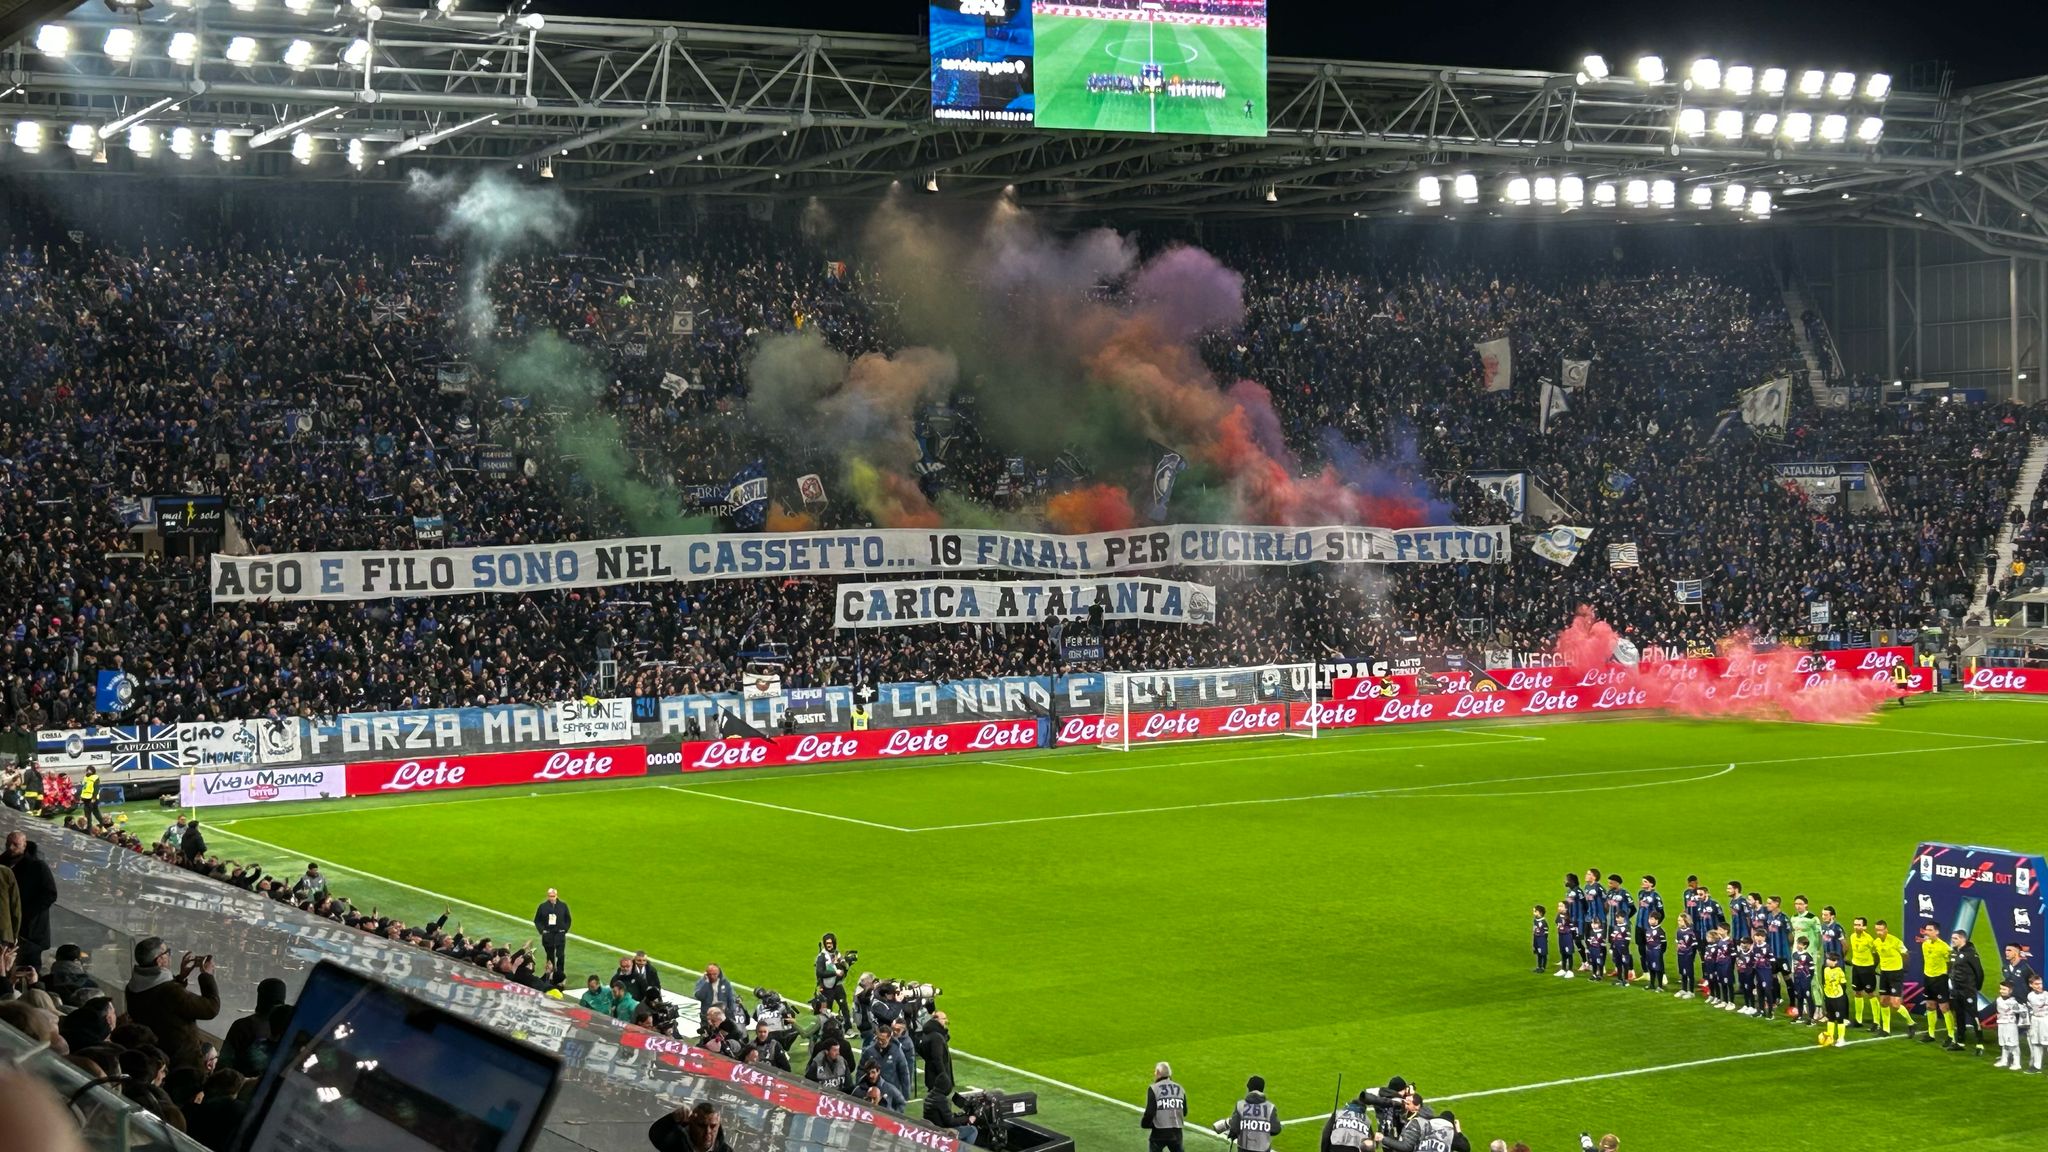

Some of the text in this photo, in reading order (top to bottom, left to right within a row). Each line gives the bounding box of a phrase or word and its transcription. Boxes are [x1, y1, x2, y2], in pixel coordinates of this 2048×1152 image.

[1783, 465, 1836, 476] ATALANTA
[215, 559, 303, 595] AGO
[320, 559, 344, 593] E
[361, 556, 455, 593] FILO
[472, 550, 579, 588] SONO
[595, 544, 672, 580] NEL
[688, 536, 915, 575] CASSETTO...
[976, 535, 1090, 569] FINALI
[1104, 532, 1170, 567] PER
[1180, 531, 1313, 560] CUCIRLO
[1326, 532, 1384, 560] SUL
[1395, 531, 1504, 563] PETTO!
[843, 583, 1183, 622] CARICA ATALANTA
[1291, 661, 1389, 692] ULTRAS
[1506, 671, 1553, 690] Lete
[1581, 668, 1626, 687] Lete
[1965, 669, 2027, 690] Lete
[1448, 694, 1505, 718] Lete
[1522, 690, 1578, 713] Lete
[1592, 685, 1647, 708] Lete
[310, 713, 463, 754] FORZA
[892, 685, 938, 717] LA
[956, 679, 1050, 714] NORD
[1192, 673, 1238, 700] TE
[1218, 707, 1281, 732] Lete
[1296, 702, 1357, 726] Lete
[1374, 699, 1434, 722] Lete
[180, 725, 224, 742] CIAO
[967, 723, 1035, 749] Lete
[1057, 718, 1119, 743] Lete
[1137, 712, 1200, 738] Lete
[116, 741, 172, 752] CAPIZZONE
[786, 735, 858, 762] Lete
[879, 728, 948, 755] Lete
[533, 751, 613, 779] Lete
[647, 752, 682, 765] 00:00
[692, 741, 767, 768] Lete
[203, 773, 241, 794] Viva
[256, 771, 324, 786] Mamma
[381, 761, 466, 790] Lete
[1935, 864, 1958, 877] KEEP
[1995, 872, 2013, 885] OUT
[1159, 1084, 1180, 1096] 317
[1243, 1103, 1268, 1117] 261
